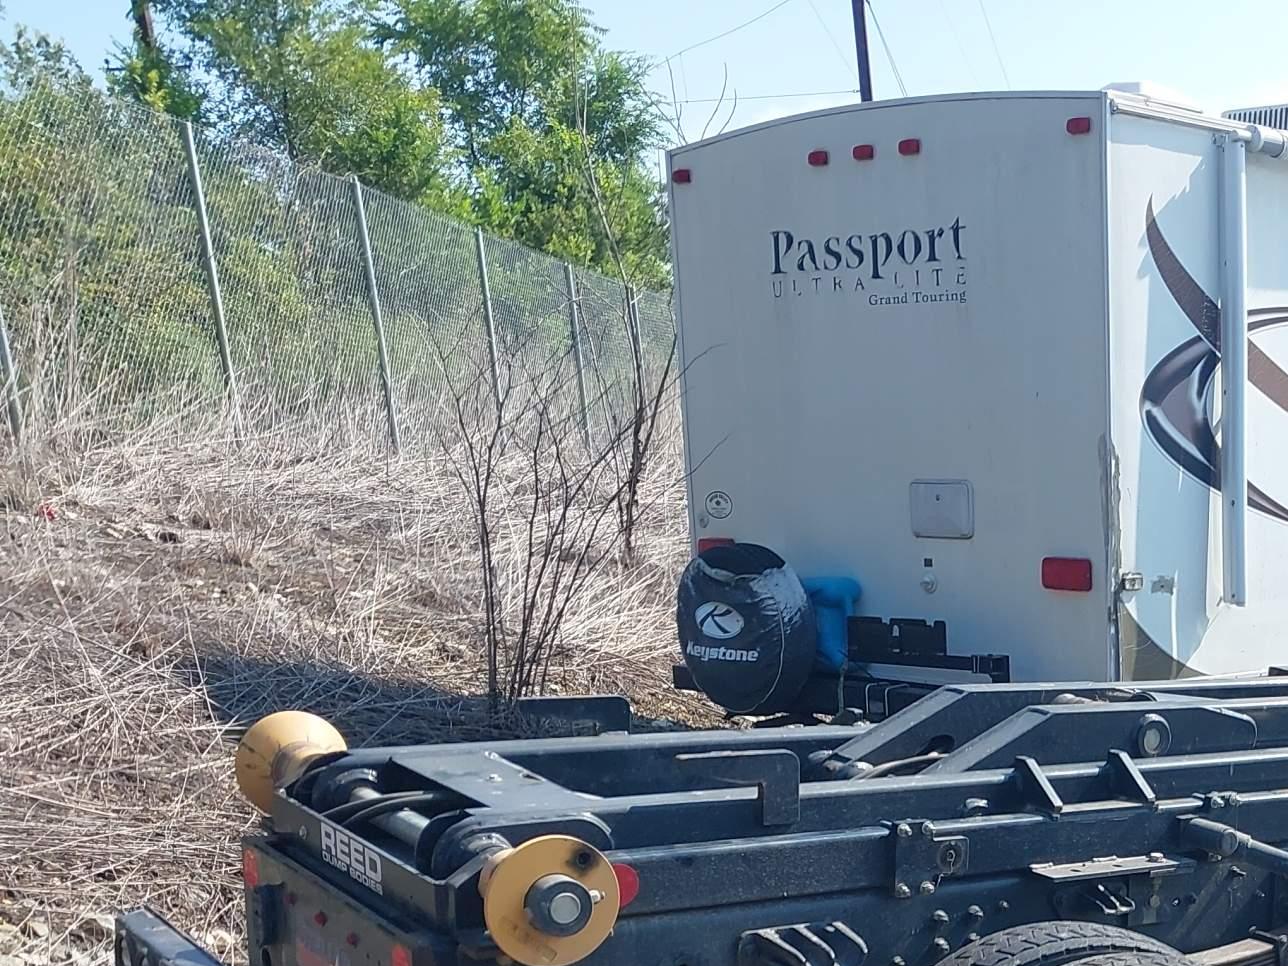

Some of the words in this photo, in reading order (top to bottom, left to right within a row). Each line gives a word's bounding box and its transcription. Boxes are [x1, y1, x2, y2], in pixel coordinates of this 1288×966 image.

[770, 216, 966, 279] Passport
[772, 277, 865, 298] ULTRA
[894, 267, 967, 288] LITE
[868, 293, 908, 306] Grand
[912, 290, 967, 304] Touring
[686, 640, 759, 662] Keystone
[321, 821, 382, 882] REED
[322, 850, 348, 873] DUMP
[349, 867, 384, 896] BODIES
